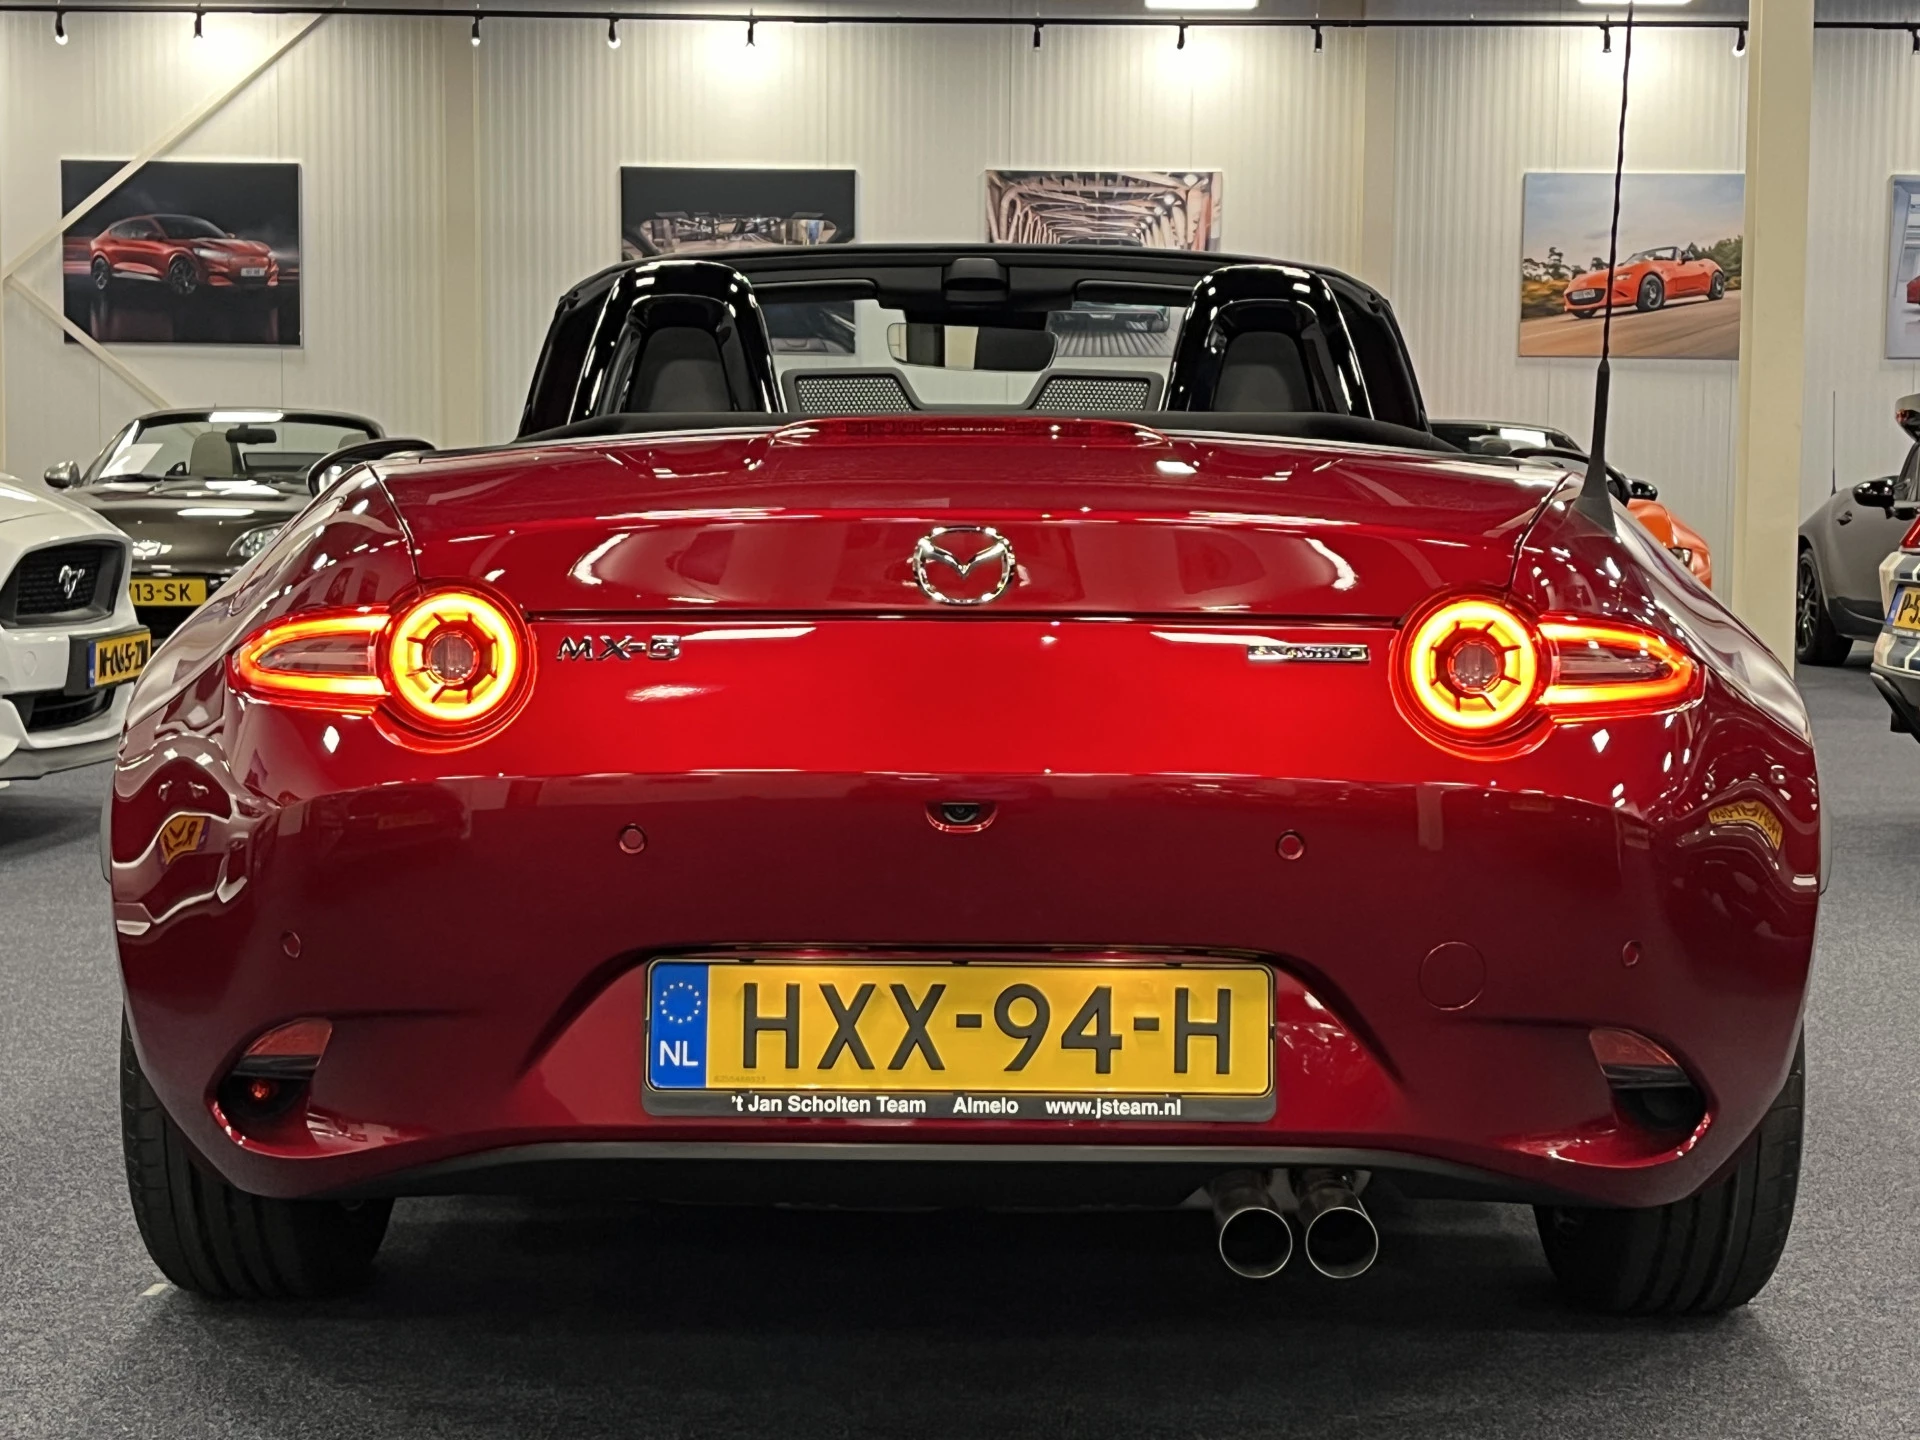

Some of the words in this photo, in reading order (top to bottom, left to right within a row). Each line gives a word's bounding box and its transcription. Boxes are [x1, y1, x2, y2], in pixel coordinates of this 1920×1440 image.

[129, 583, 192, 602] 13-SK
[556, 635, 682, 661] MX-5
[743, 982, 1231, 1075] HXX-94-H
[659, 1040, 698, 1066] NL
[748, 1095, 782, 1113] Jan
[787, 1095, 870, 1113] Scholten
[877, 1096, 926, 1113] Team
[953, 1097, 1019, 1114] Almelo
[1045, 1098, 1181, 1119] www.jsteam.nl
